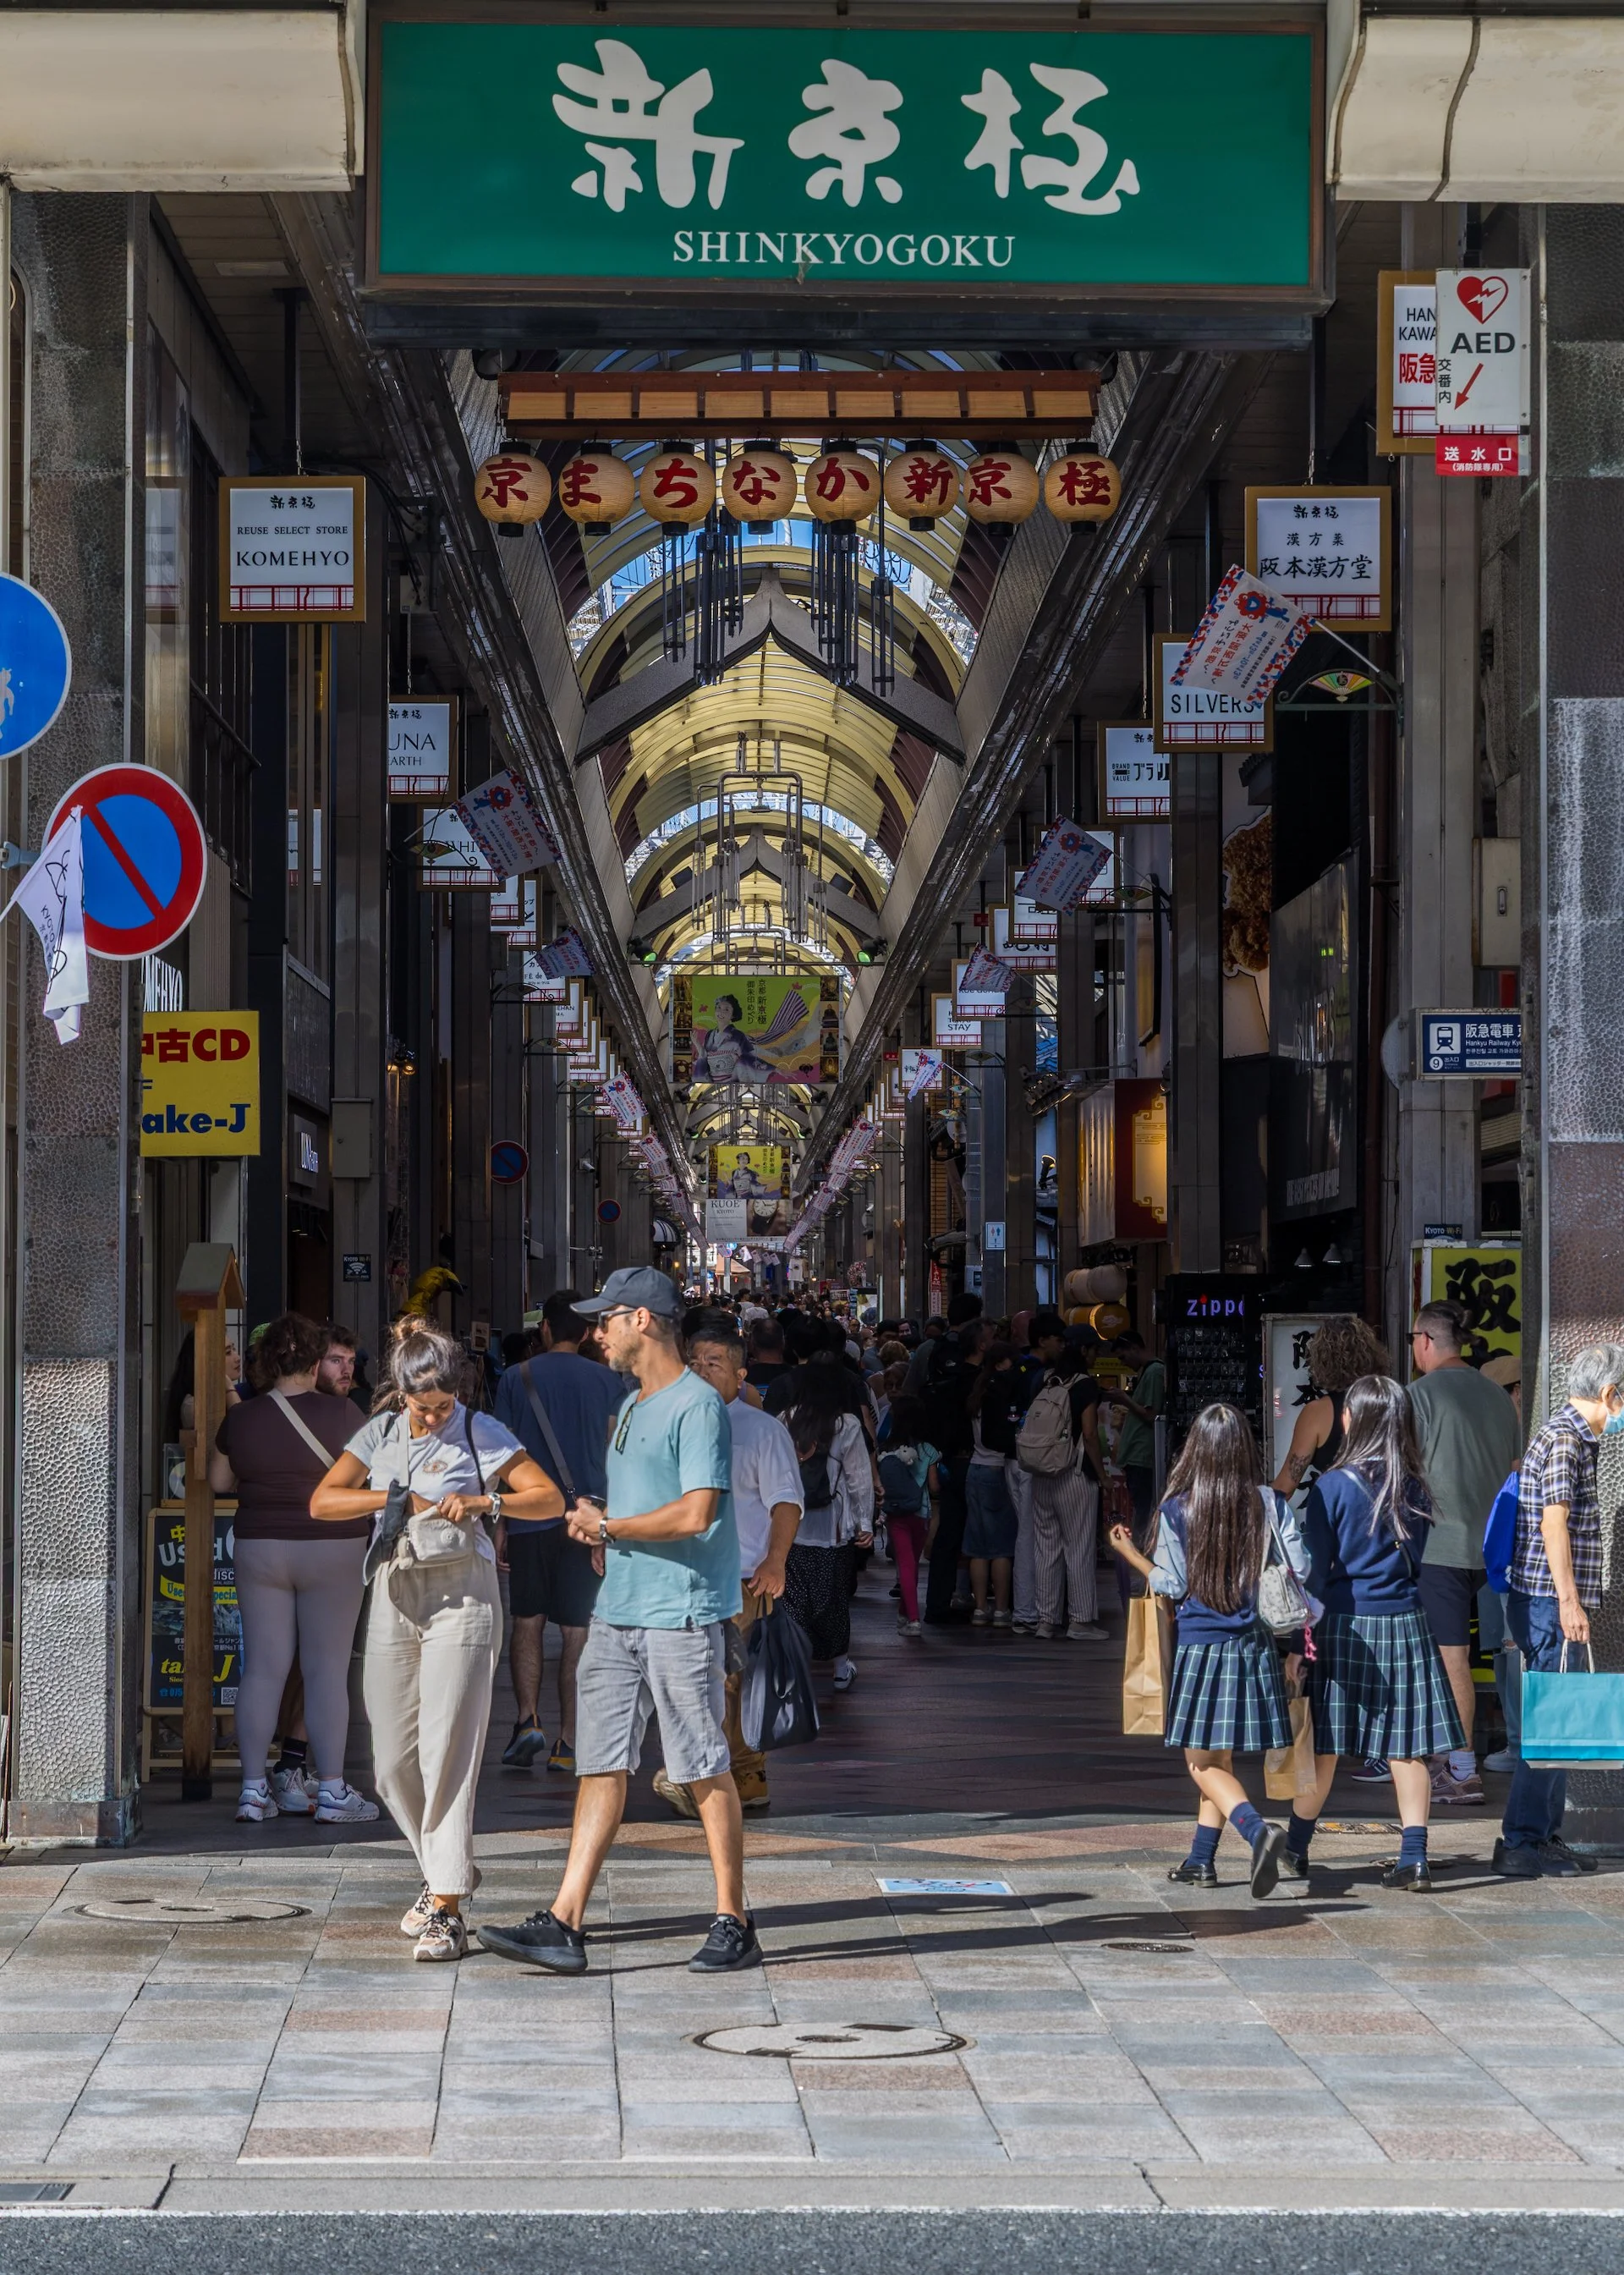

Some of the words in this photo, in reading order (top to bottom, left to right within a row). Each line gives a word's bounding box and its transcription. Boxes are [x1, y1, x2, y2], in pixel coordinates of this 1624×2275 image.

[552, 40, 1139, 214] 新京極
[673, 231, 1015, 267] SHINKYOGOKU
[1407, 307, 1436, 321] HAN
[1399, 327, 1436, 341] KAWA
[1450, 332, 1516, 354] AED
[1399, 353, 1435, 384] 阪急
[1438, 359, 1451, 404] 交番内
[1444, 446, 1512, 461] 送水口
[270, 495, 315, 509] 新京極
[1293, 504, 1339, 519] 新京極
[237, 526, 269, 535] REUSE
[274, 526, 310, 535] SELECT
[315, 525, 348, 535] STORE
[1287, 532, 1344, 547] 漢方薬
[237, 551, 349, 566] KOMEHYO
[1259, 554, 1373, 580] 阪本漢方堂
[389, 756, 422, 766] ARTH
[141, 954, 184, 1012] MEHYO
[747, 981, 755, 1025] 御朱印めぐり
[1465, 1023, 1514, 1038] 阪急電車
[710, 1200, 740, 1208] KUOE
[158, 1537, 223, 1567] Usd
